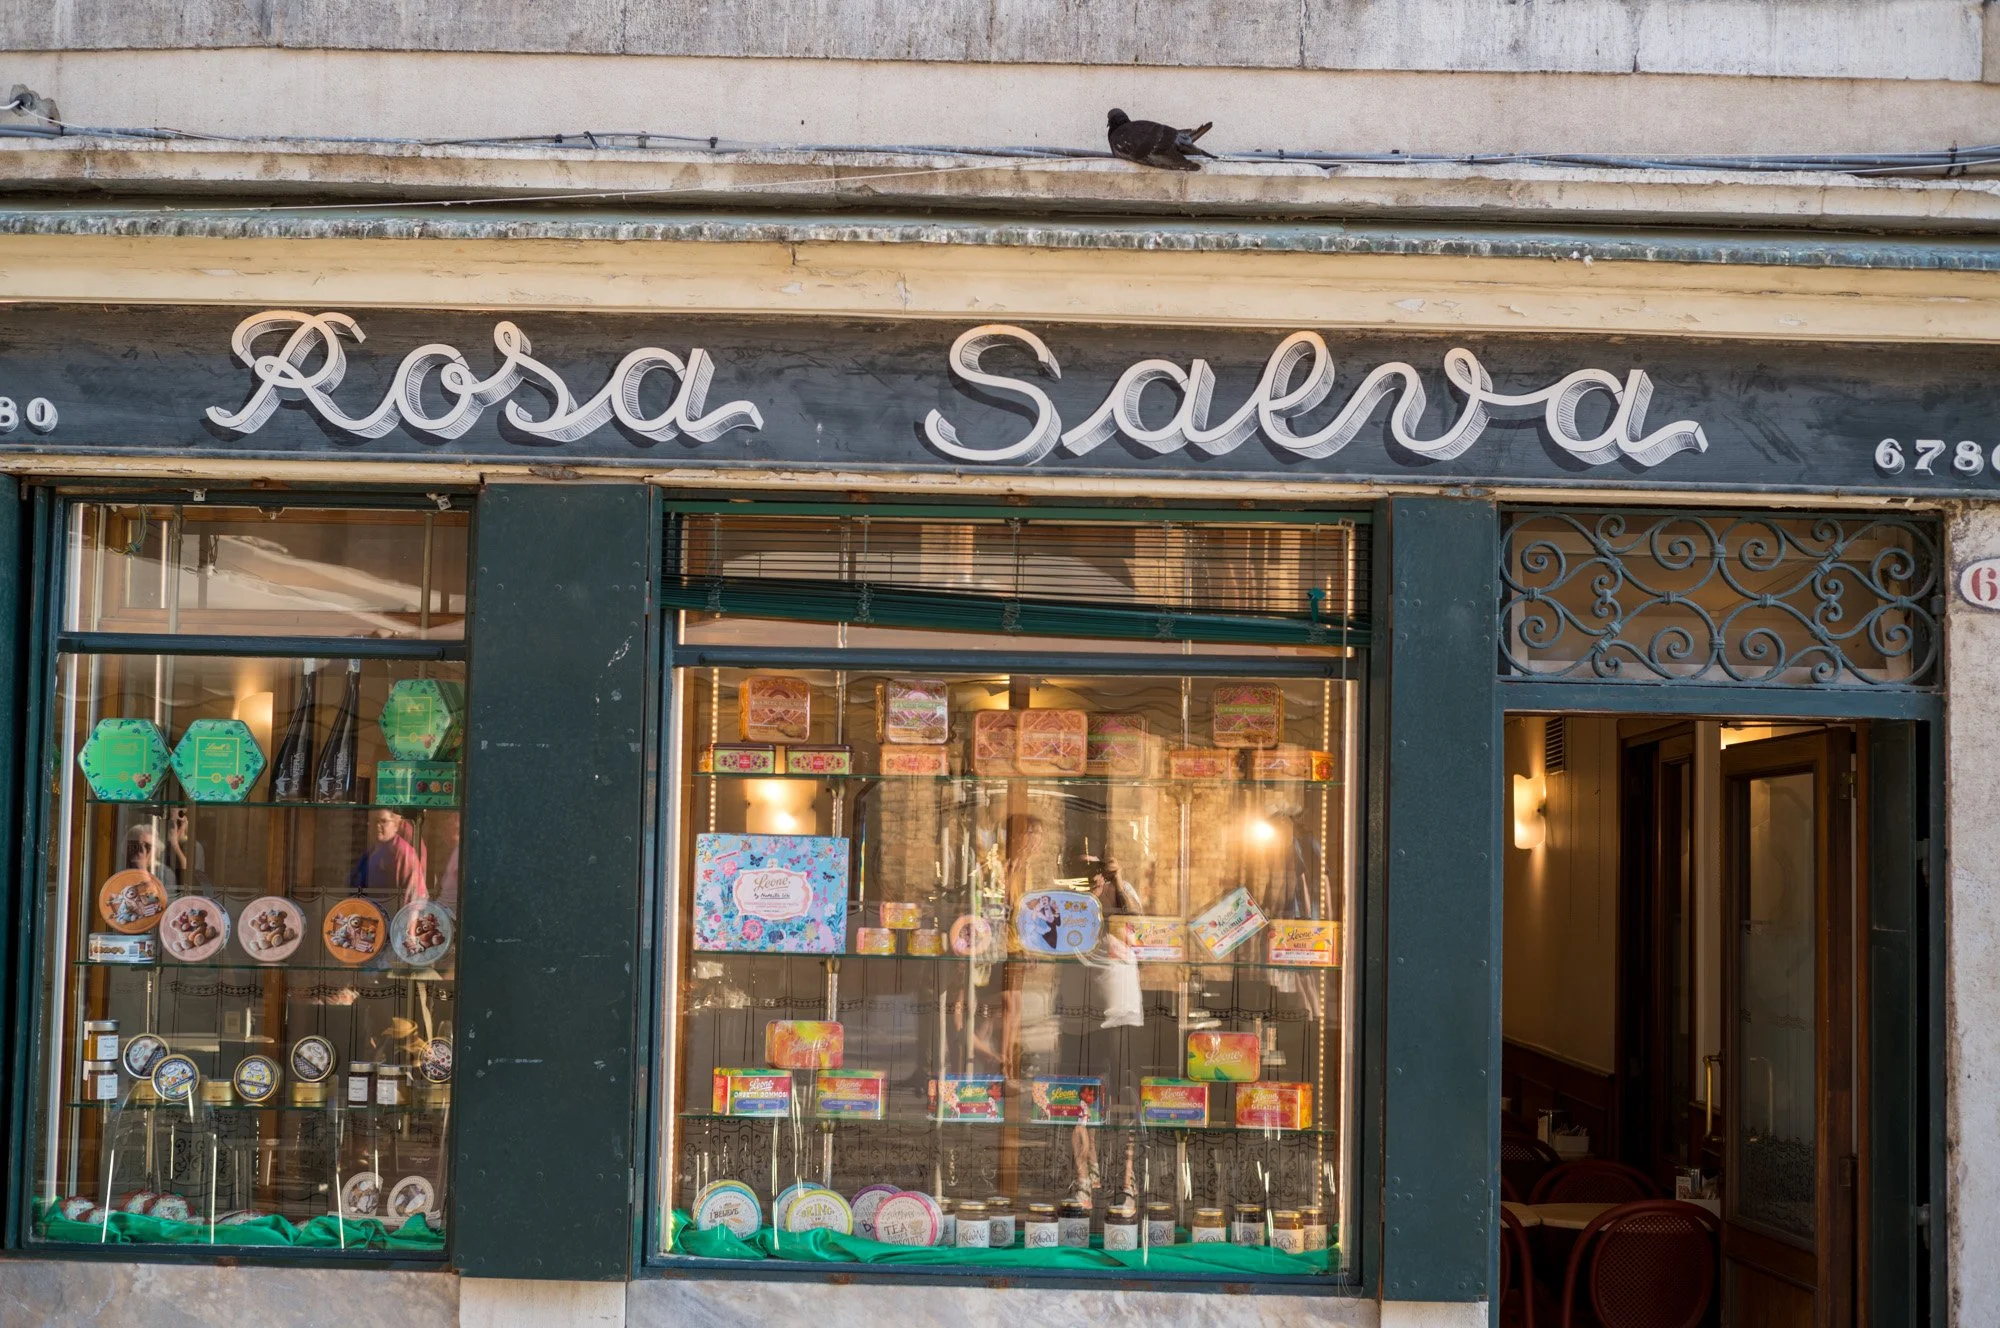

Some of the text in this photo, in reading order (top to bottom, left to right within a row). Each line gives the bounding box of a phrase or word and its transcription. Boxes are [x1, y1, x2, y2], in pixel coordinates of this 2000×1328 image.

[206, 311, 1707, 466] Rosa Salva
[1875, 438, 2000, 476] 678
[1204, 1047, 1243, 1066] Leone
[749, 1078, 775, 1092] Leone
[883, 1222, 908, 1236] TEA
